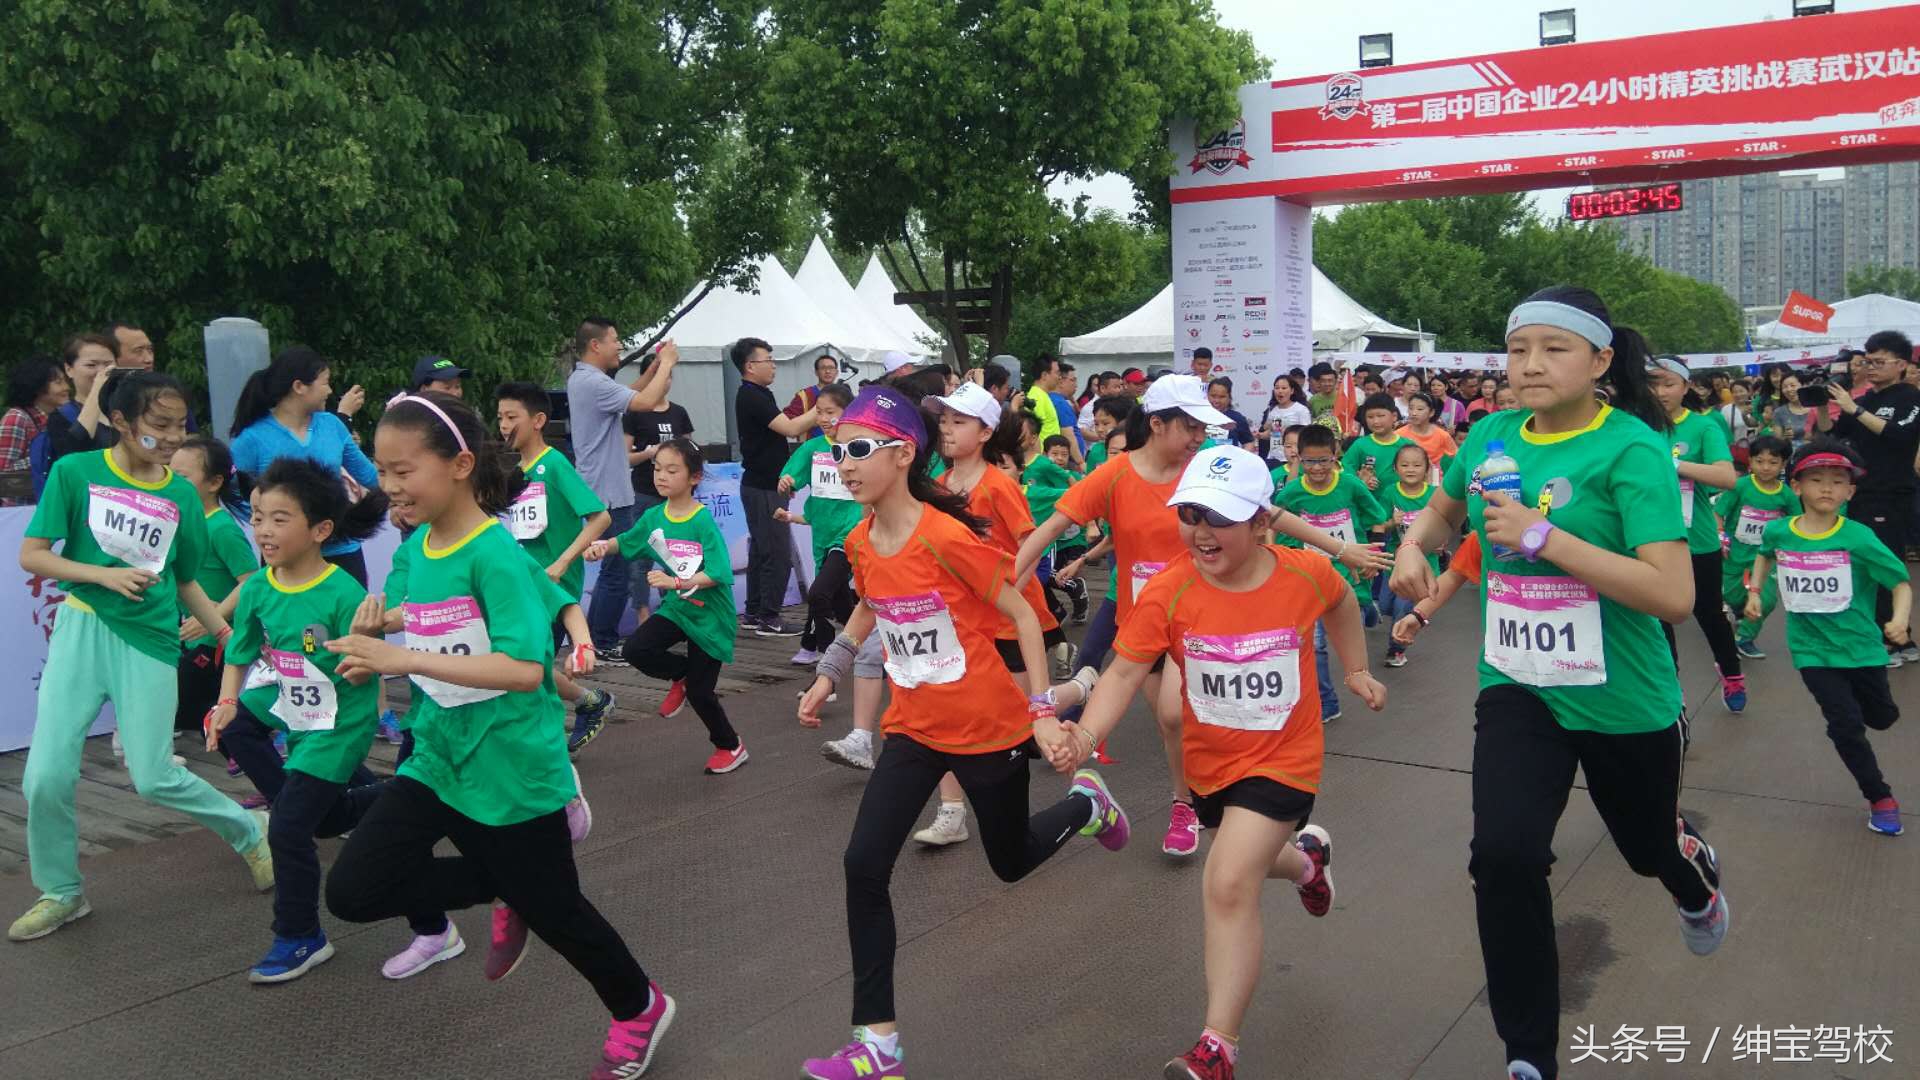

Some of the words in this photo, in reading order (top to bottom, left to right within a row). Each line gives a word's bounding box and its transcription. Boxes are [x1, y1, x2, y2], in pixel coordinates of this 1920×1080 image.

[1371, 47, 1920, 129] 第二届中国企业24小时精英挑战赛武汉站
[1743, 142, 1779, 153] STAR
[1839, 133, 1878, 146] STAR
[1564, 156, 1598, 167] STAR
[1651, 149, 1686, 160] STAR
[1403, 170, 1433, 182] STAR
[1481, 163, 1512, 175] STAR
[1571, 184, 1681, 219] 00:02:45
[104, 508, 162, 548] M116
[1785, 575, 1839, 594] M209
[885, 628, 939, 657] M127
[1499, 617, 1576, 652] M101
[1201, 670, 1283, 700] M199
